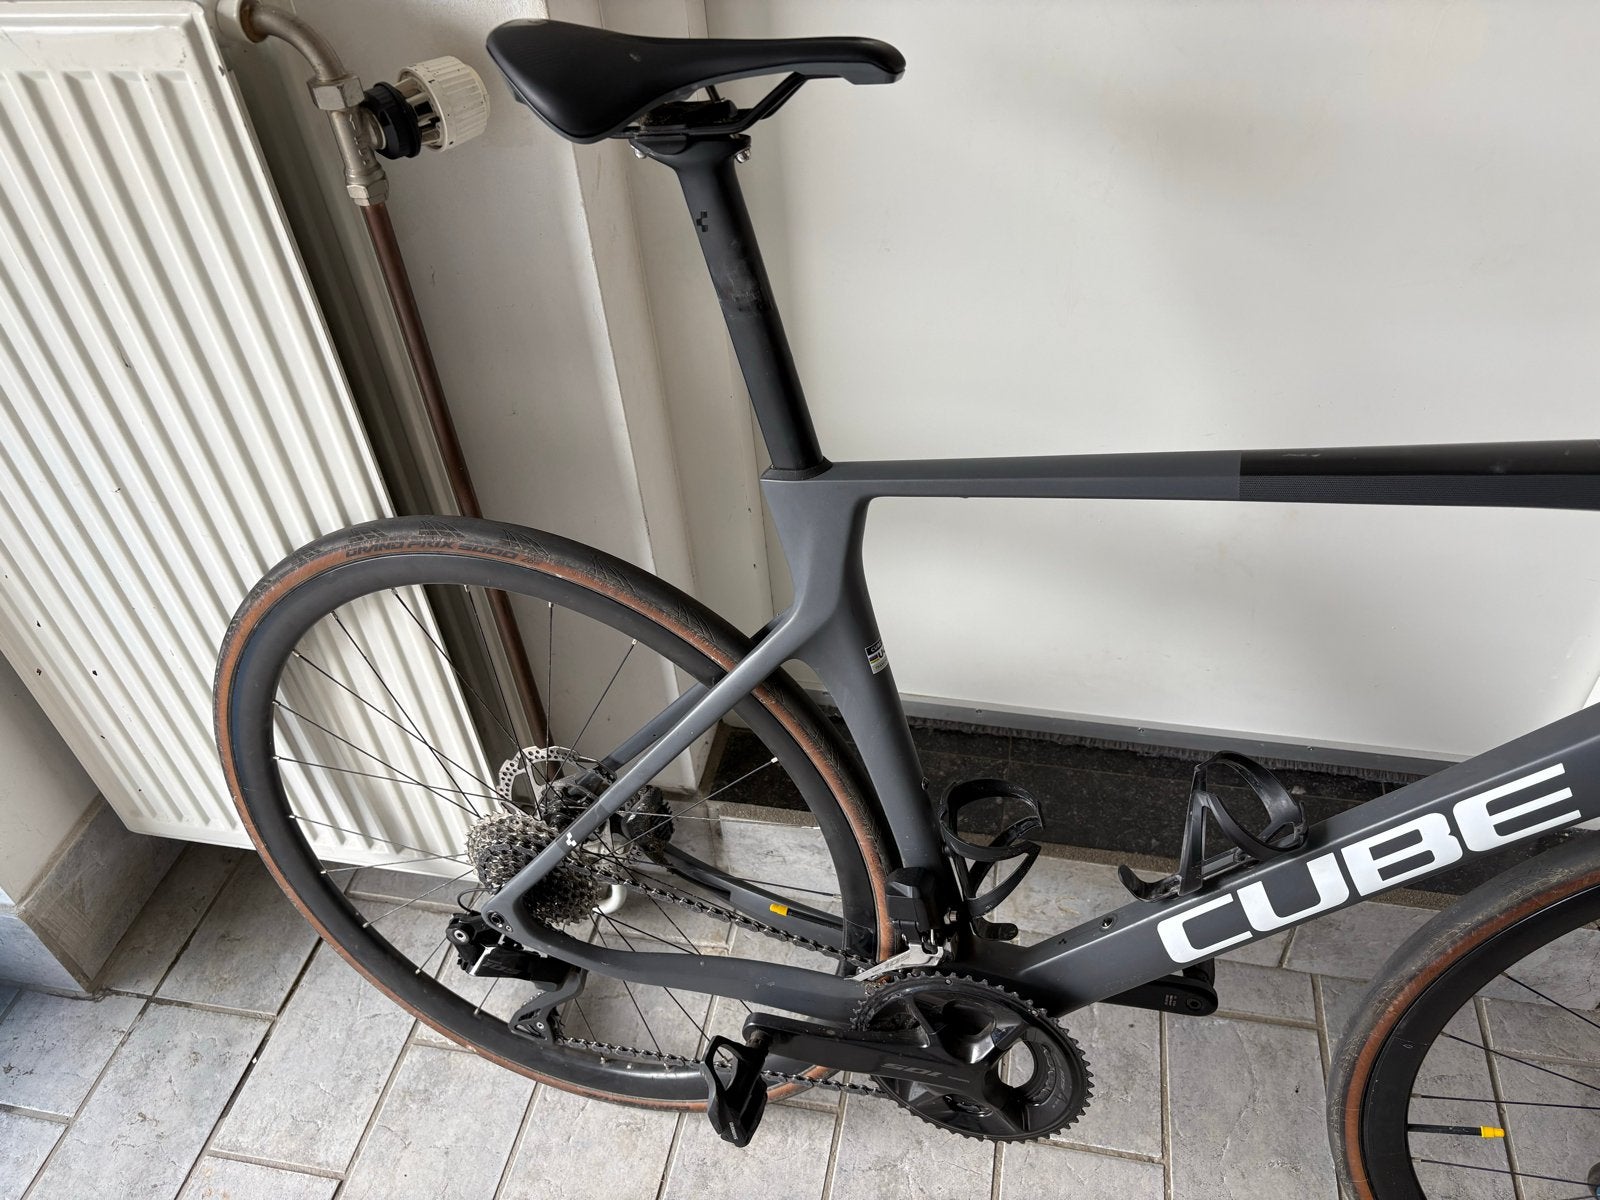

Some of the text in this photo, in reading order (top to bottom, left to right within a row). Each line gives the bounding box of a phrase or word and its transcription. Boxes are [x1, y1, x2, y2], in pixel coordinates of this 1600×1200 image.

[345, 540, 404, 558] GRAND
[407, 539, 454, 549] PRIX
[459, 542, 519, 559] 5000
[1156, 762, 1582, 964] CUBE
